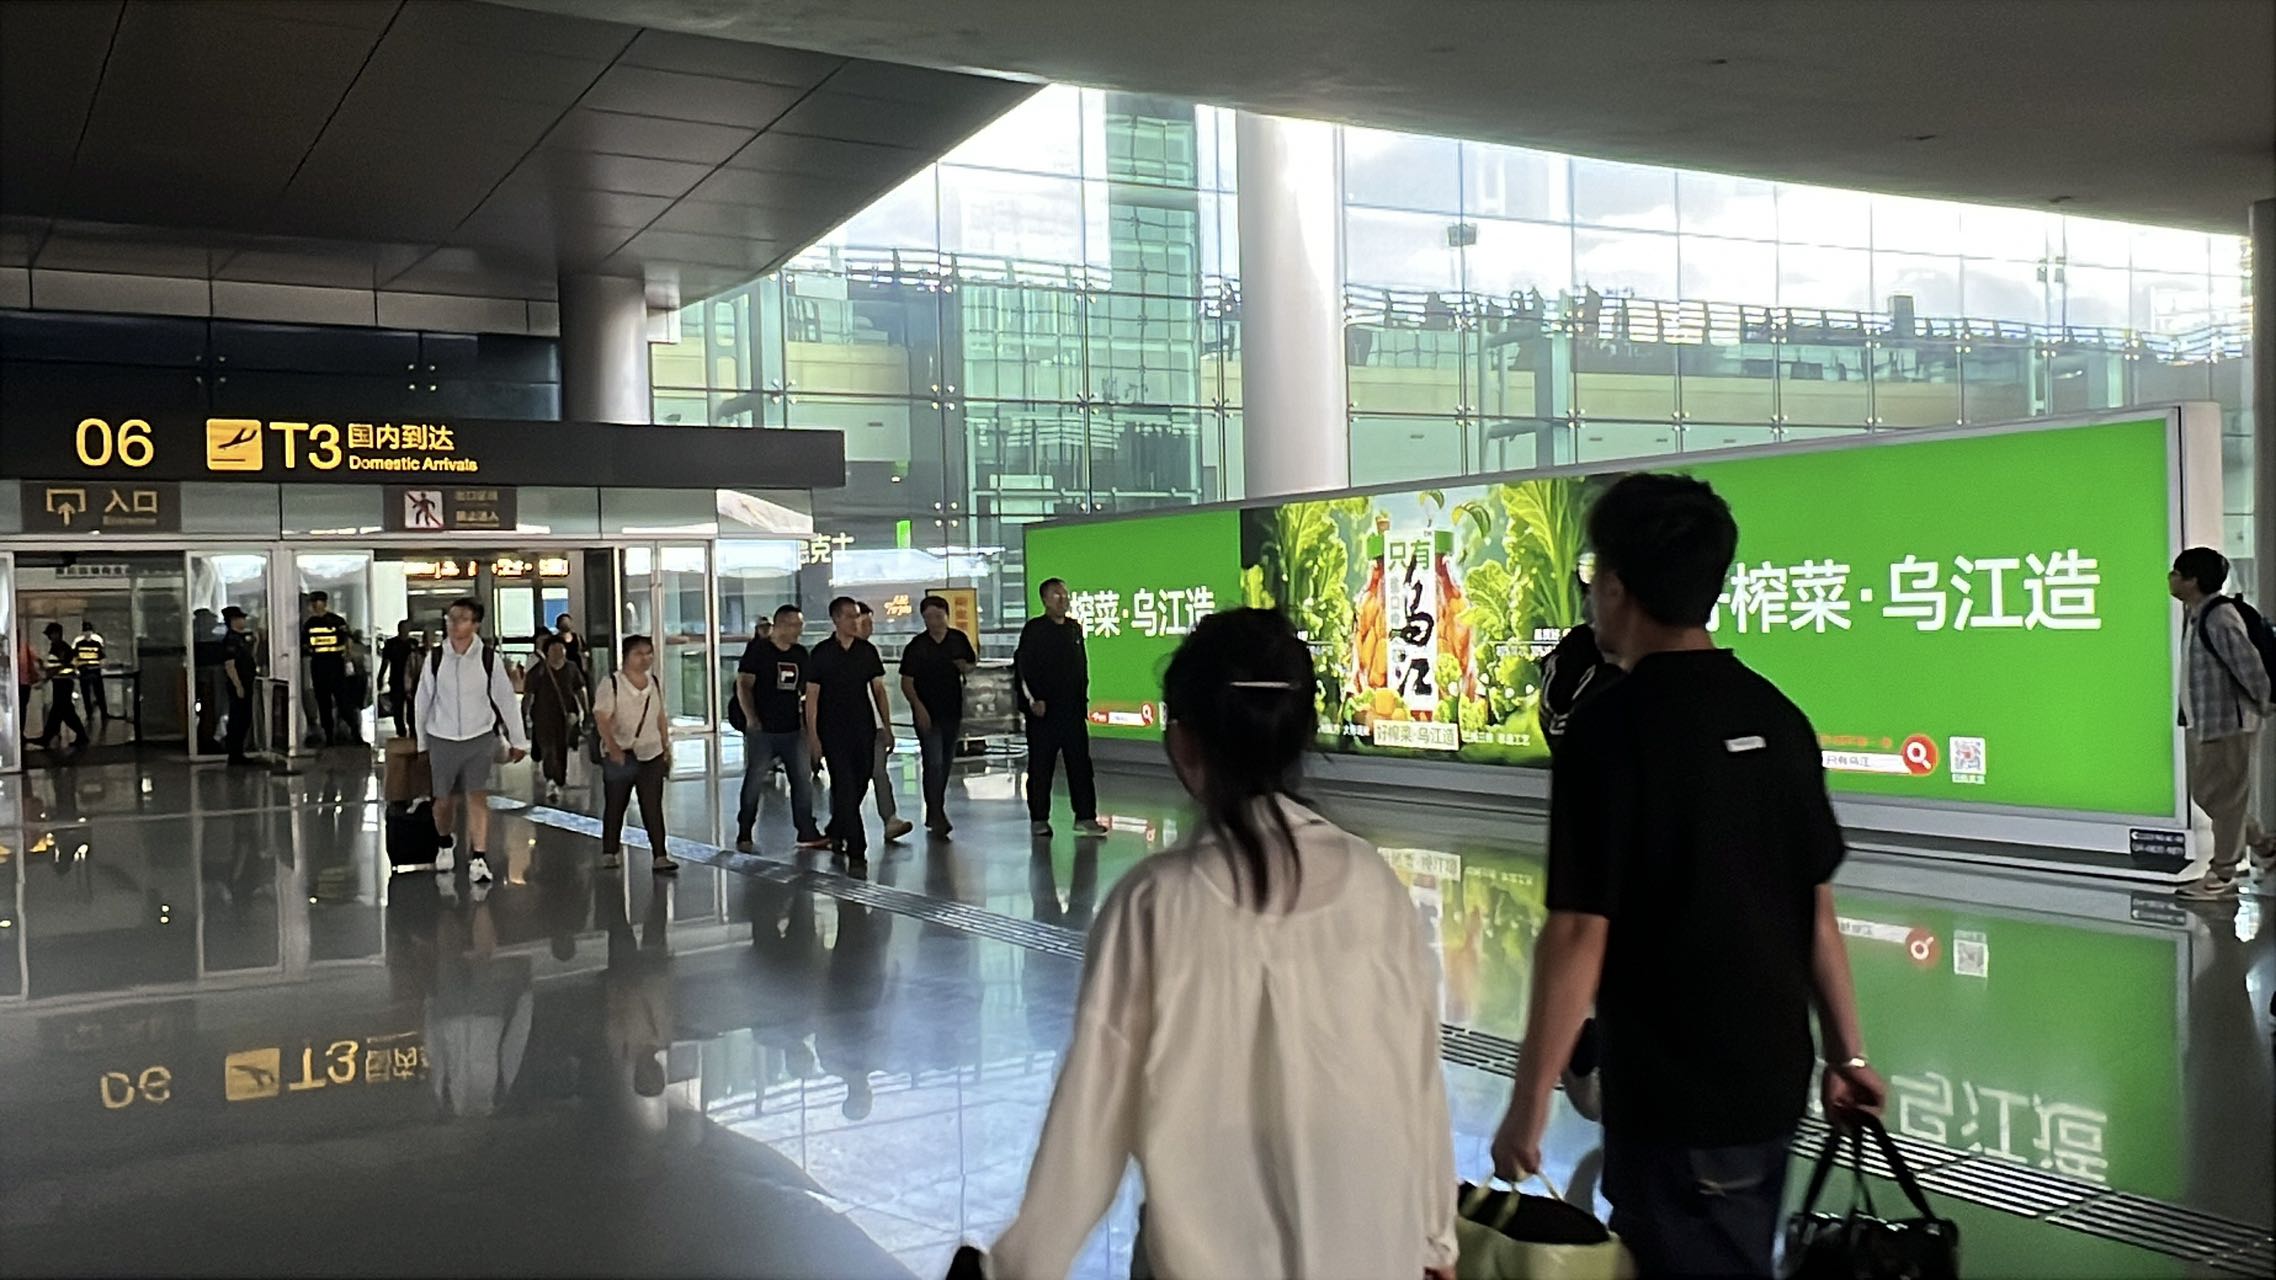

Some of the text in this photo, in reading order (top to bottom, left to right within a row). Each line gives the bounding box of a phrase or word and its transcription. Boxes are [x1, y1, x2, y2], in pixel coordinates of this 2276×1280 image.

[75, 418, 155, 468] 06
[269, 421, 343, 470] T3
[347, 423, 456, 452] 国内到达
[349, 455, 478, 472] Domestic Arrivals
[104, 489, 158, 513] 入口
[1388, 539, 1432, 571] 只有
